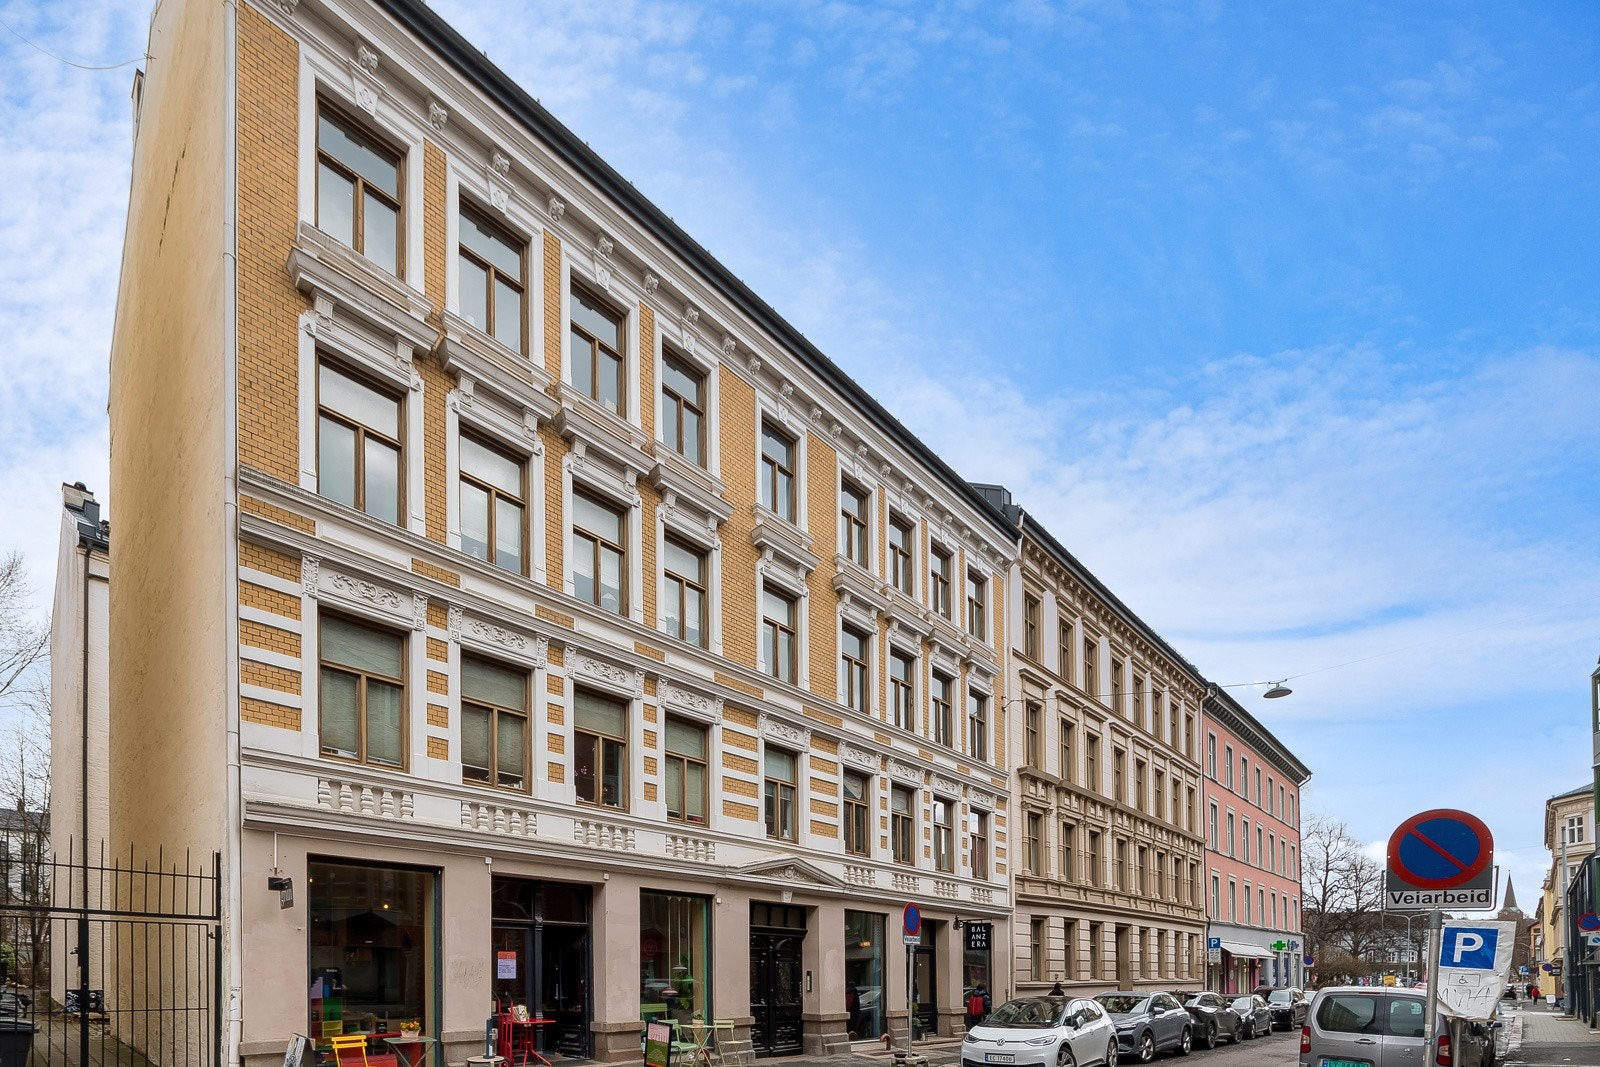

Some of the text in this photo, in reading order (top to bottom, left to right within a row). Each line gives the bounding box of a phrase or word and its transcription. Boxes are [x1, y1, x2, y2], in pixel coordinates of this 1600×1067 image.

[1390, 889, 1489, 905] Veiarbeid
[1211, 939, 1218, 947] P
[1453, 932, 1484, 963] P
